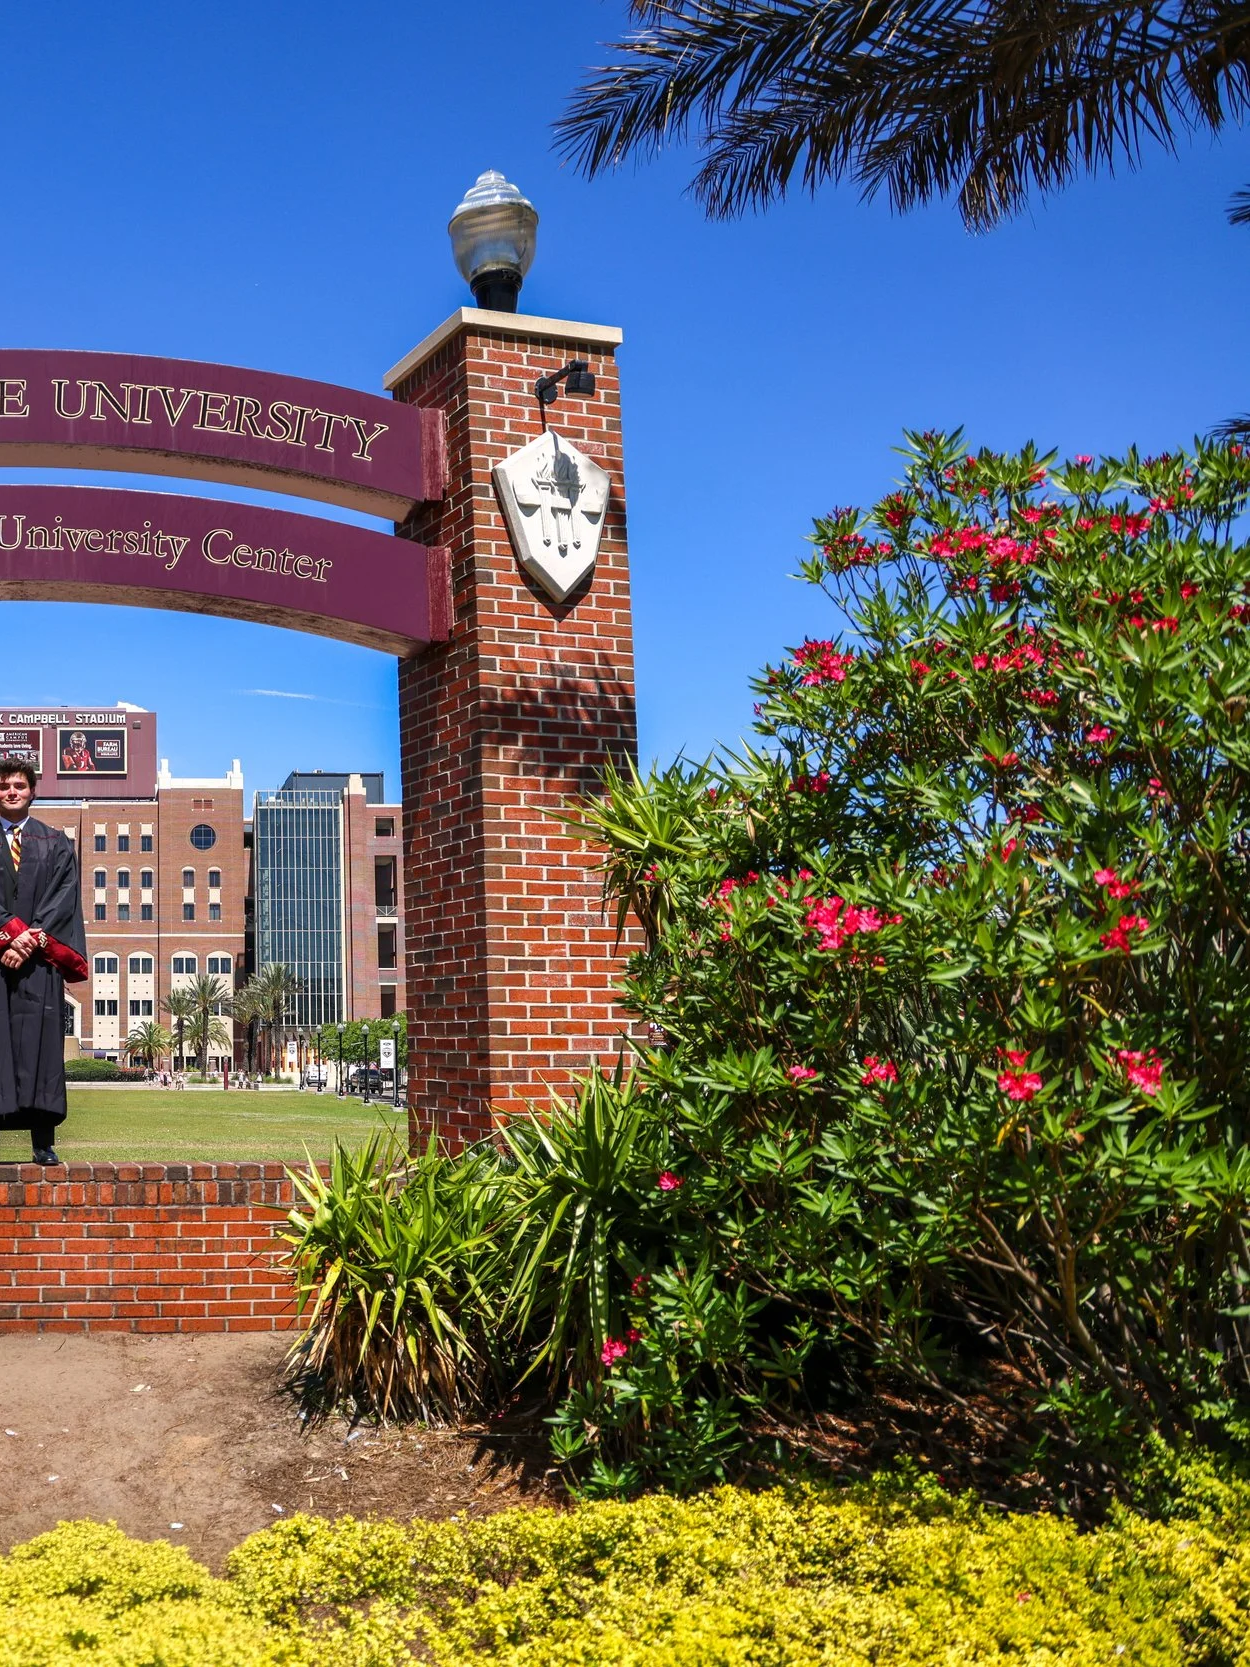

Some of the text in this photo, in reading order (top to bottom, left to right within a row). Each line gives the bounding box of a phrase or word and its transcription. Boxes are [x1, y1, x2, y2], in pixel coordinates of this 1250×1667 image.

[52, 379, 390, 462] UNIVERSITY
[201, 528, 334, 583] Center
[9, 714, 70, 724] CAMPBELL
[75, 714, 126, 724] STADIUM
